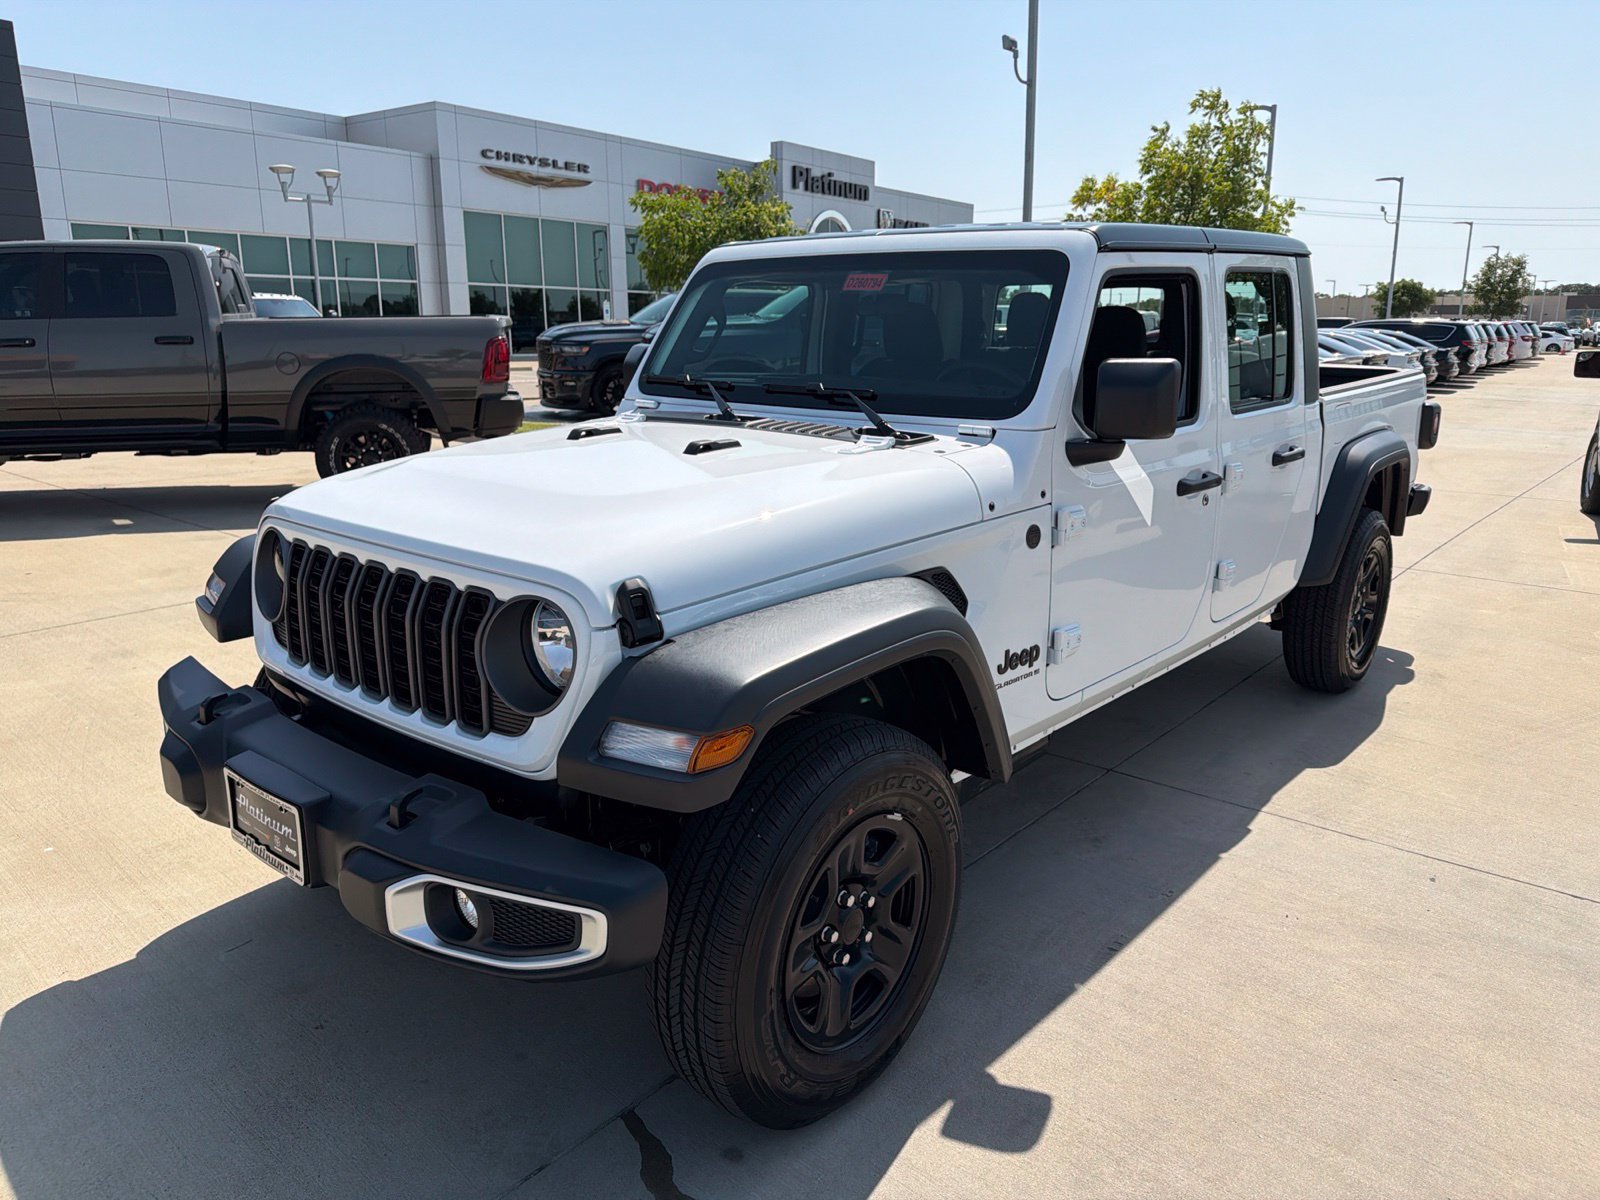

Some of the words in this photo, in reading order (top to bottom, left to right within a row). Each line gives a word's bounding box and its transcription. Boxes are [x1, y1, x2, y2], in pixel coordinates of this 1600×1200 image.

[480, 149, 590, 174] CHRYSLER
[792, 166, 869, 202] Platinum
[997, 644, 1040, 675] Jeep
[236, 794, 296, 842] Platinum
